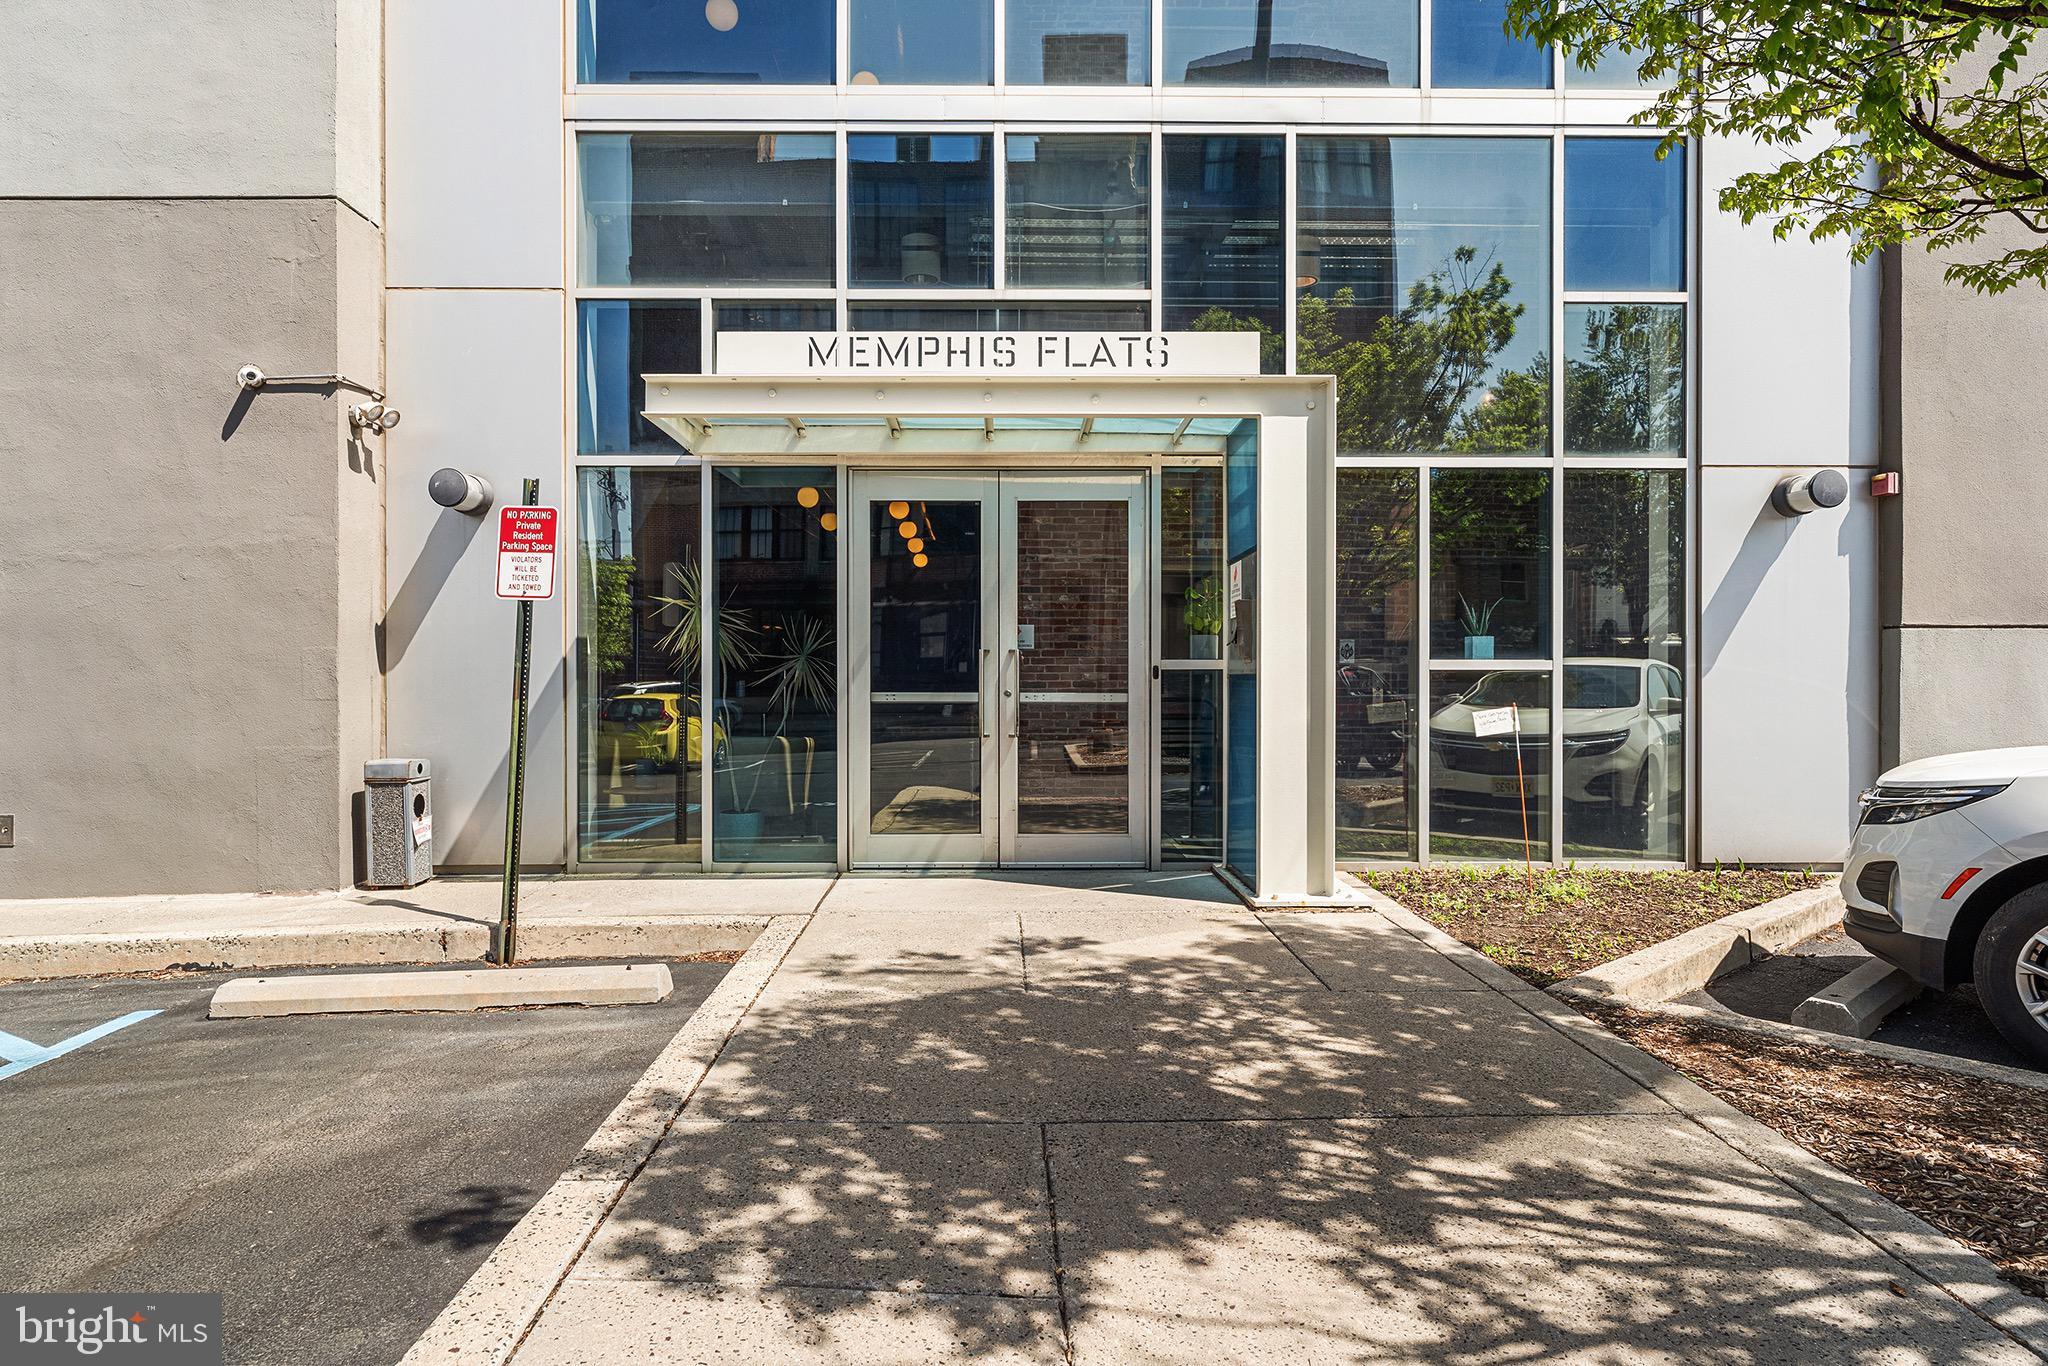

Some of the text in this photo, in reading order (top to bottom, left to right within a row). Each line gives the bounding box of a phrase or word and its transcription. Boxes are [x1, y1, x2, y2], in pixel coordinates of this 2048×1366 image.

[807, 336, 1169, 368] MEMPHIS FLATS
[507, 511, 552, 520] NO PARKING
[516, 521, 542, 530] Private
[513, 531, 544, 540] Resident
[501, 541, 553, 552] Parking Space
